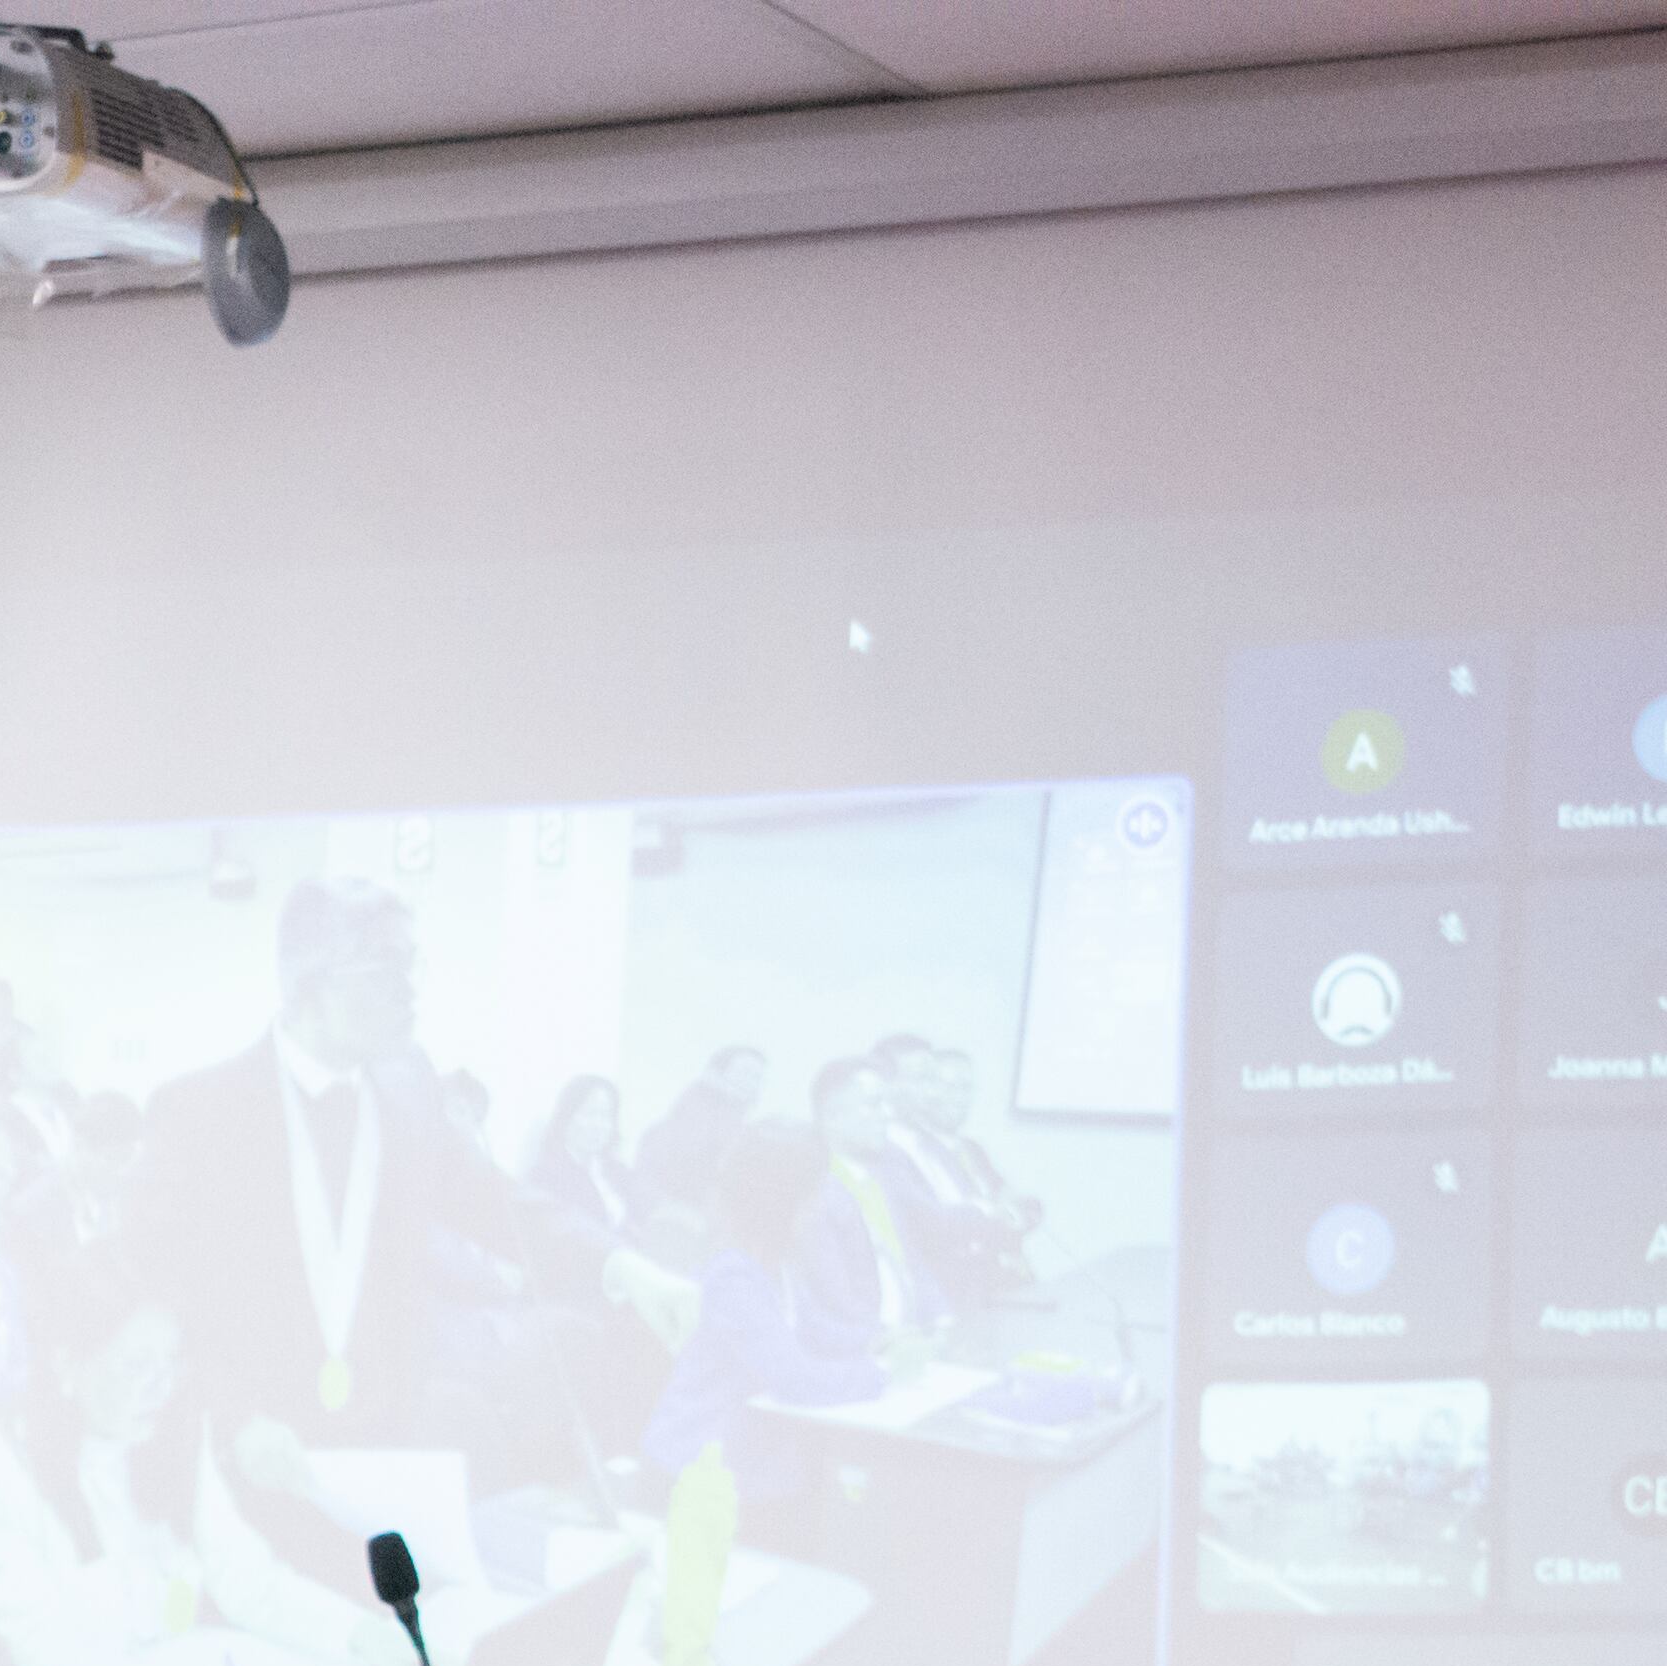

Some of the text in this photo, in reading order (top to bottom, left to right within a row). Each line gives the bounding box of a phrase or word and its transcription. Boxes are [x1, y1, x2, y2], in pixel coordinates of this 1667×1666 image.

[1345, 730, 1379, 773] A
[1557, 801, 1636, 830] Edwin
[1335, 1231, 1364, 1268] C
